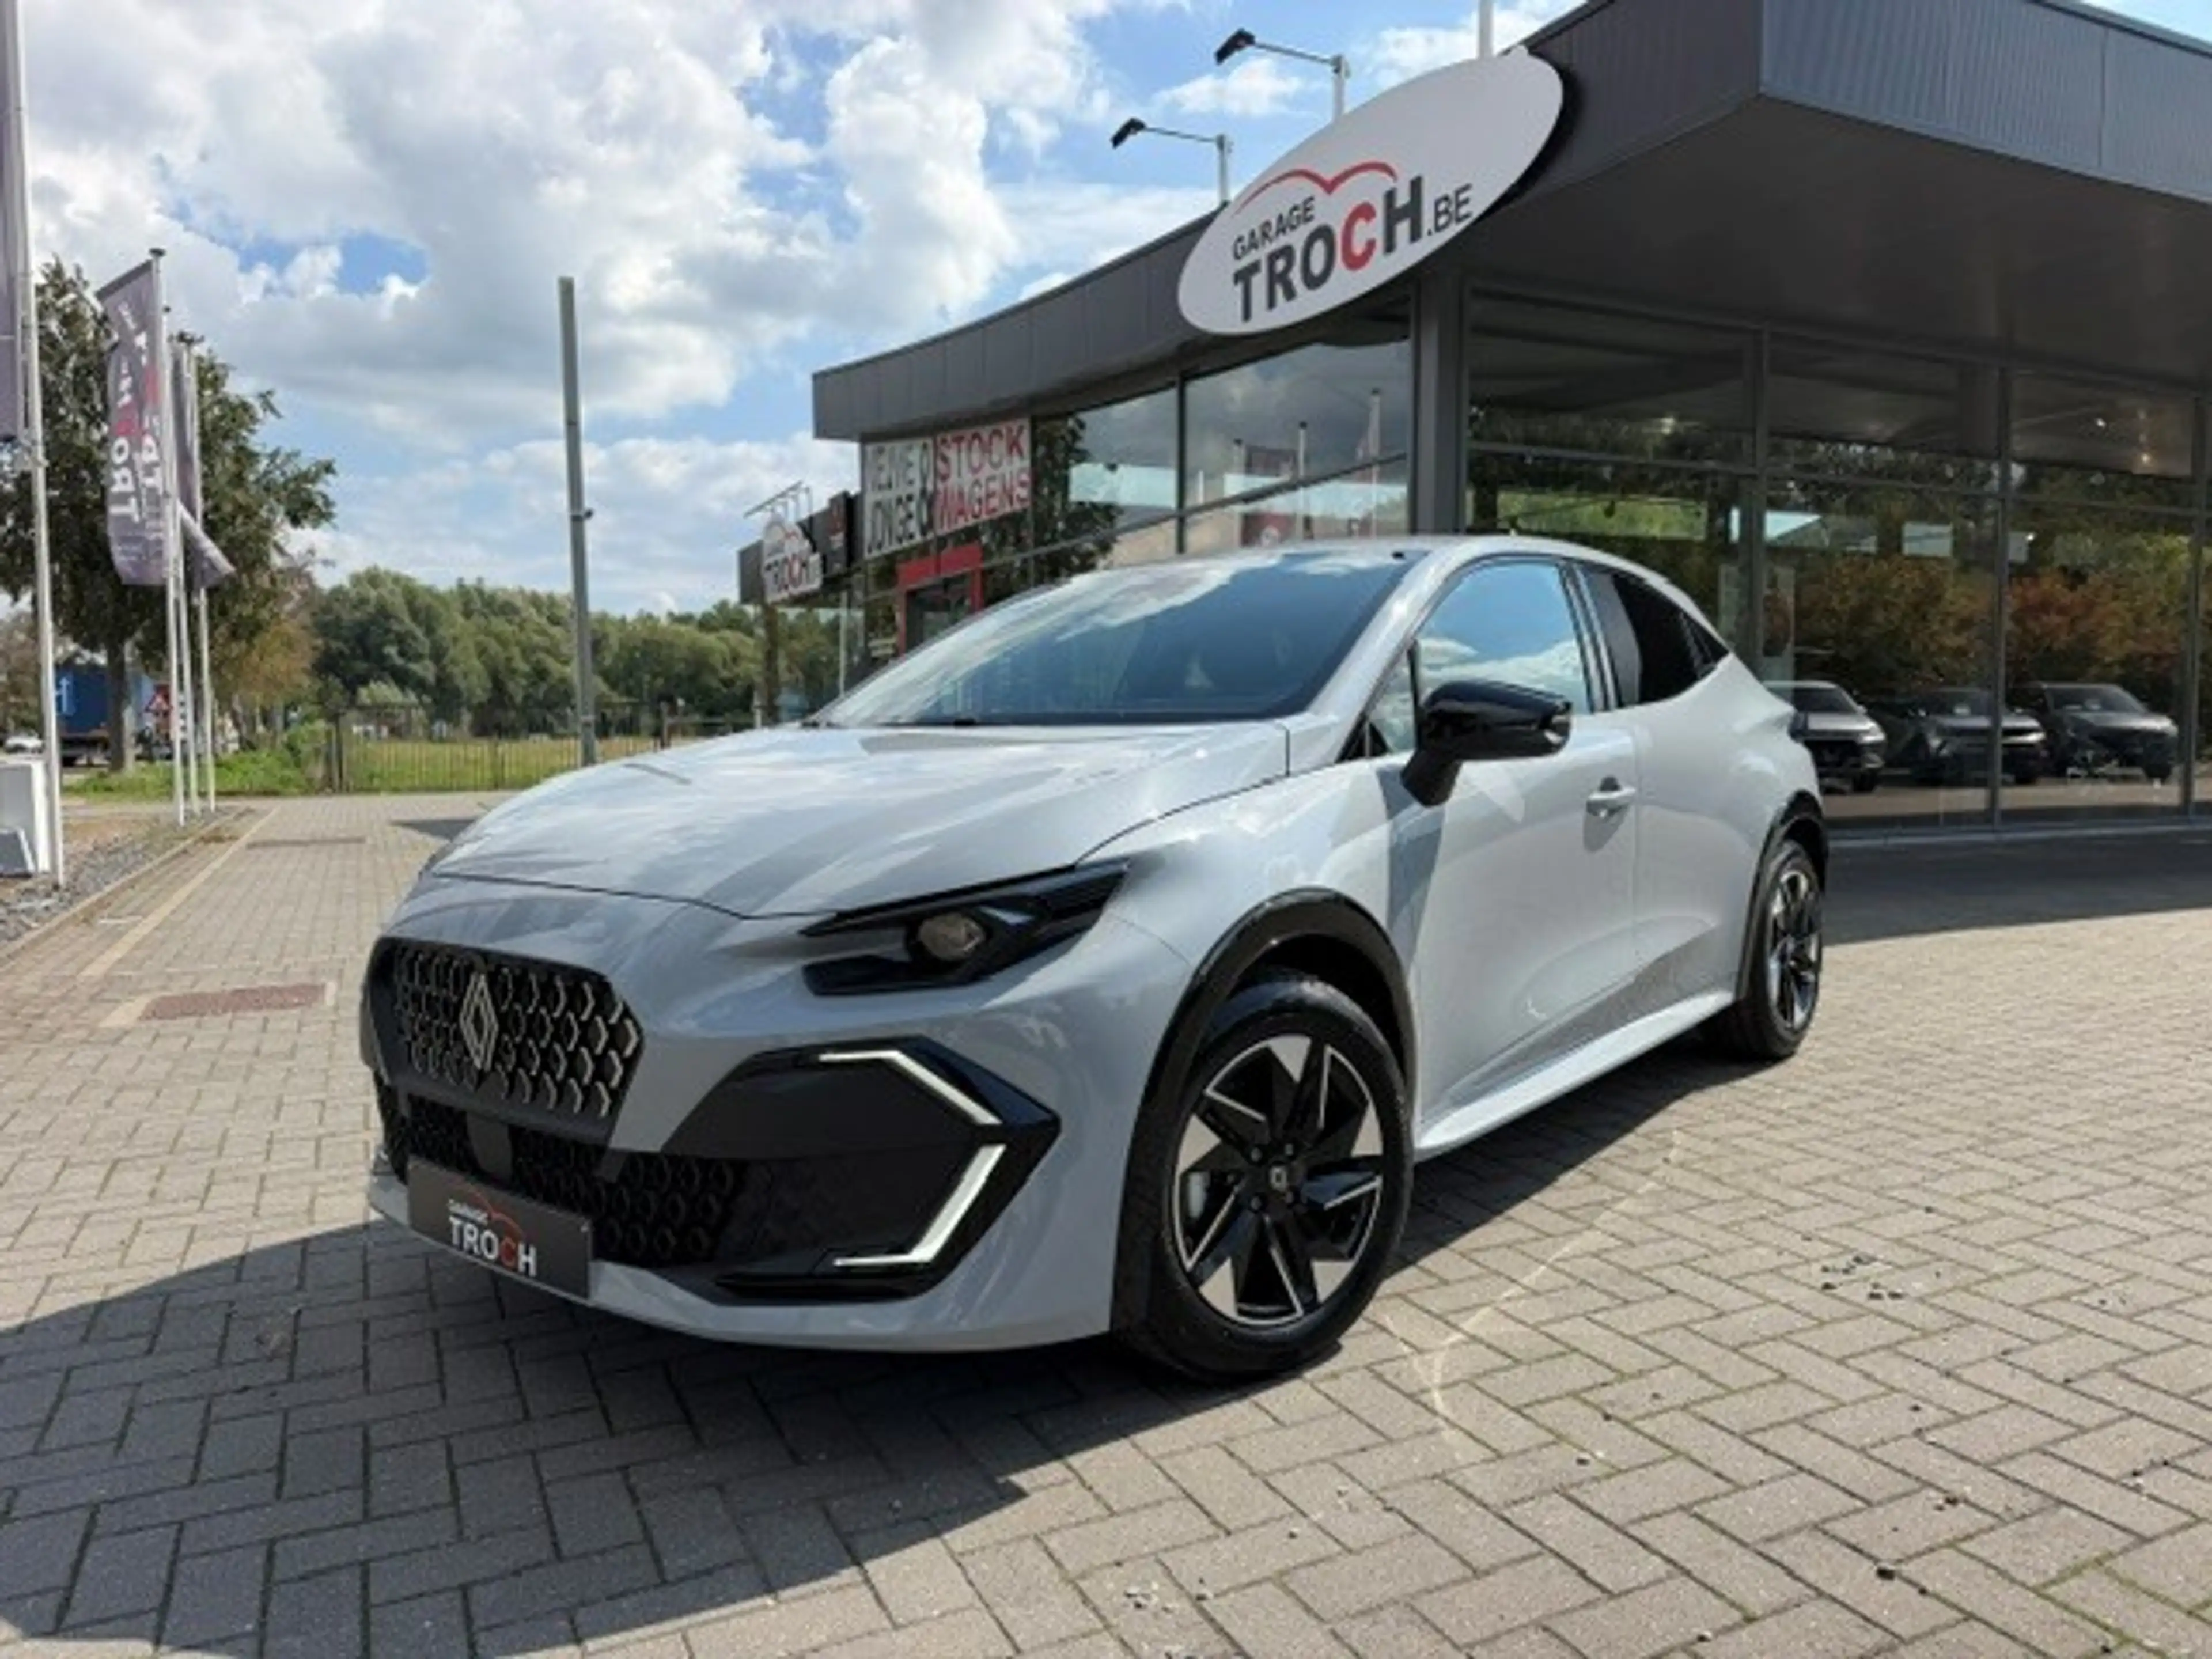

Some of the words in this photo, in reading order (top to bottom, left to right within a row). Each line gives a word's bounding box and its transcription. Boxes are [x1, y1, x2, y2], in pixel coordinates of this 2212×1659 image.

[1232, 196, 1316, 261] GARAGE
[937, 425, 1025, 482] STOCK
[937, 467, 1030, 531] WAGENS
[449, 1216, 537, 1277] TROCH
